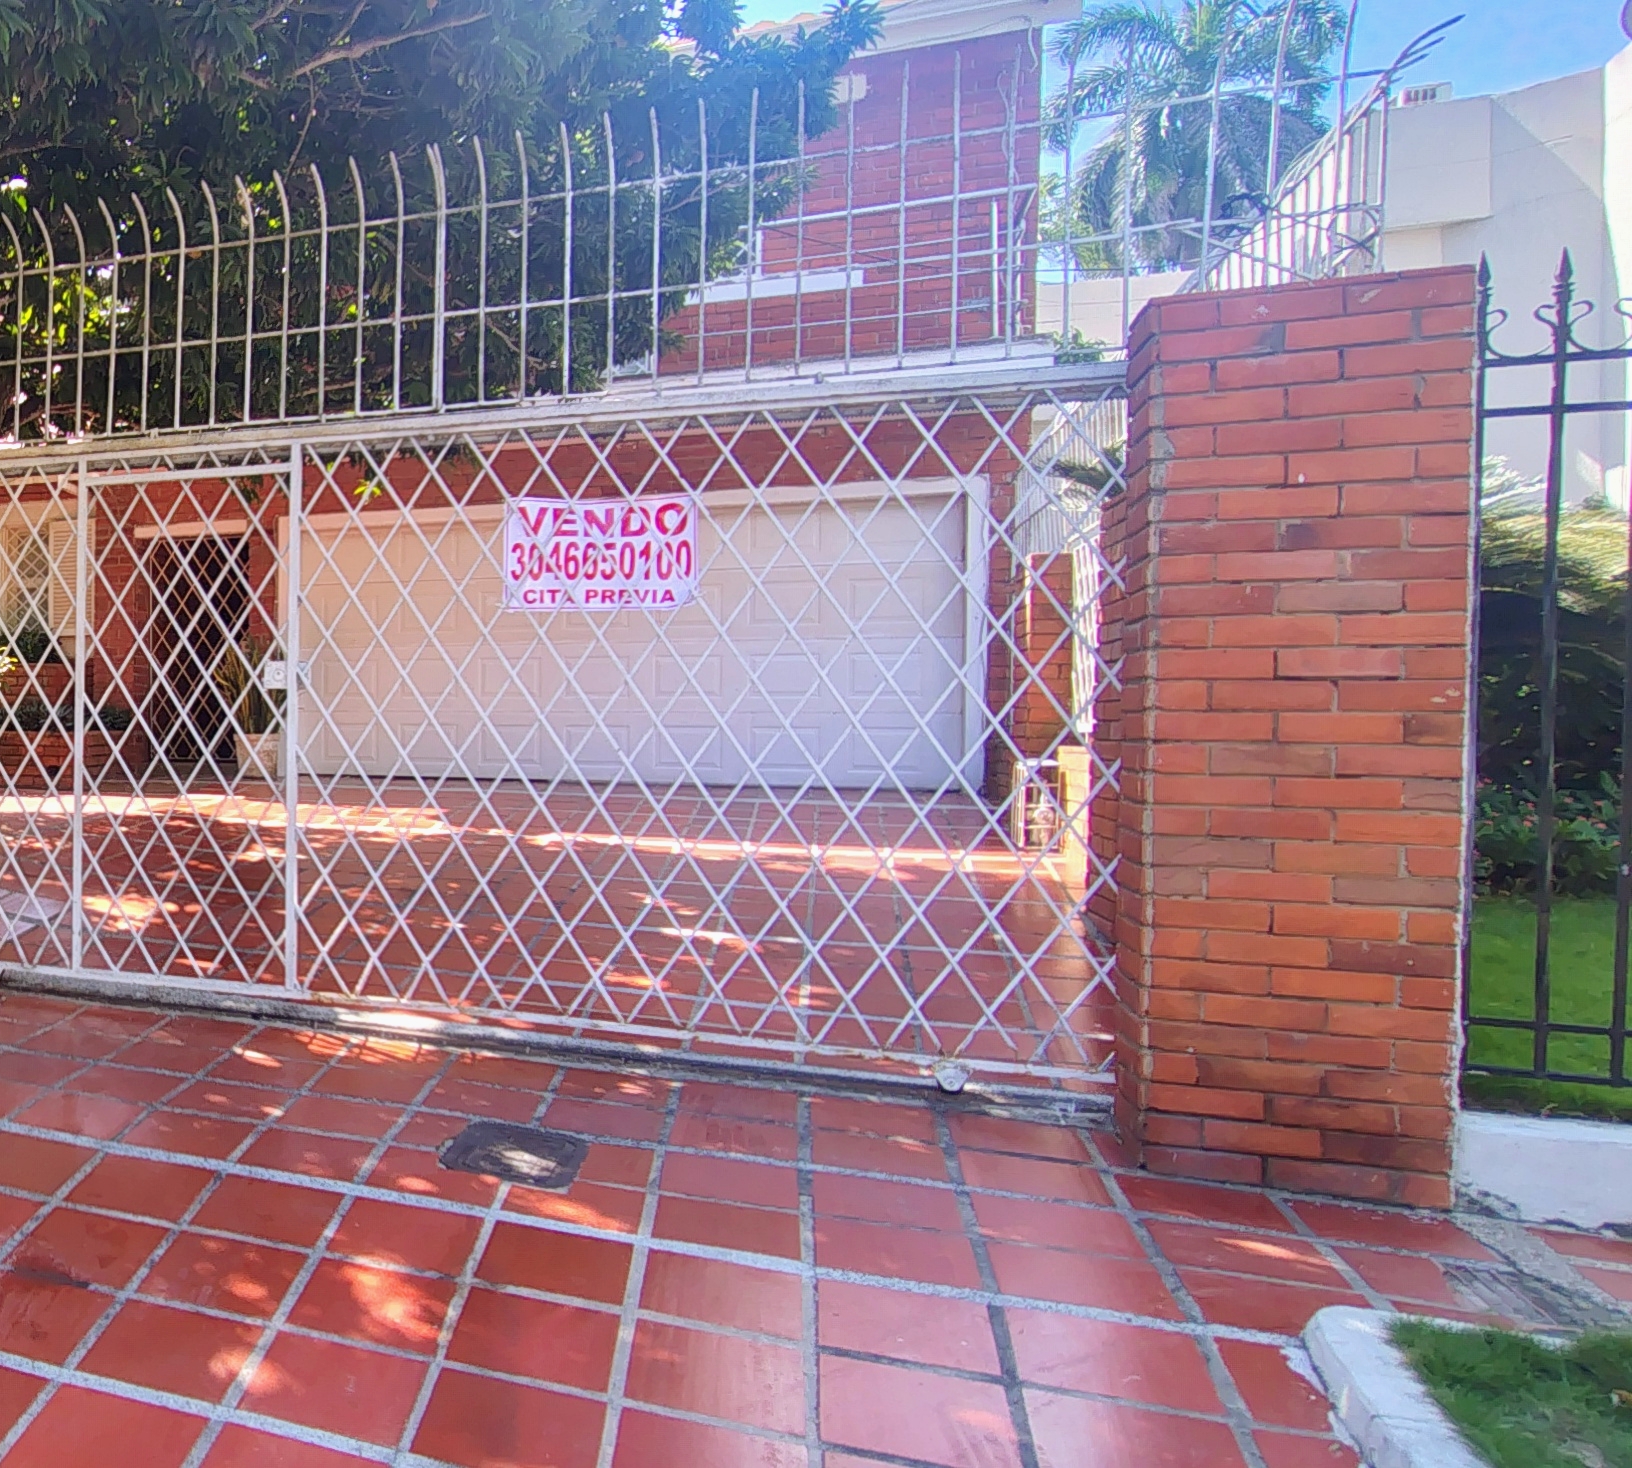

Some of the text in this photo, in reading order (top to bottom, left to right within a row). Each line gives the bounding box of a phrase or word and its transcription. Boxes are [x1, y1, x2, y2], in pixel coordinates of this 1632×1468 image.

[518, 503, 688, 538] VENDO
[511, 540, 692, 581] 3046650100
[523, 589, 676, 604] CITA PREVIA
